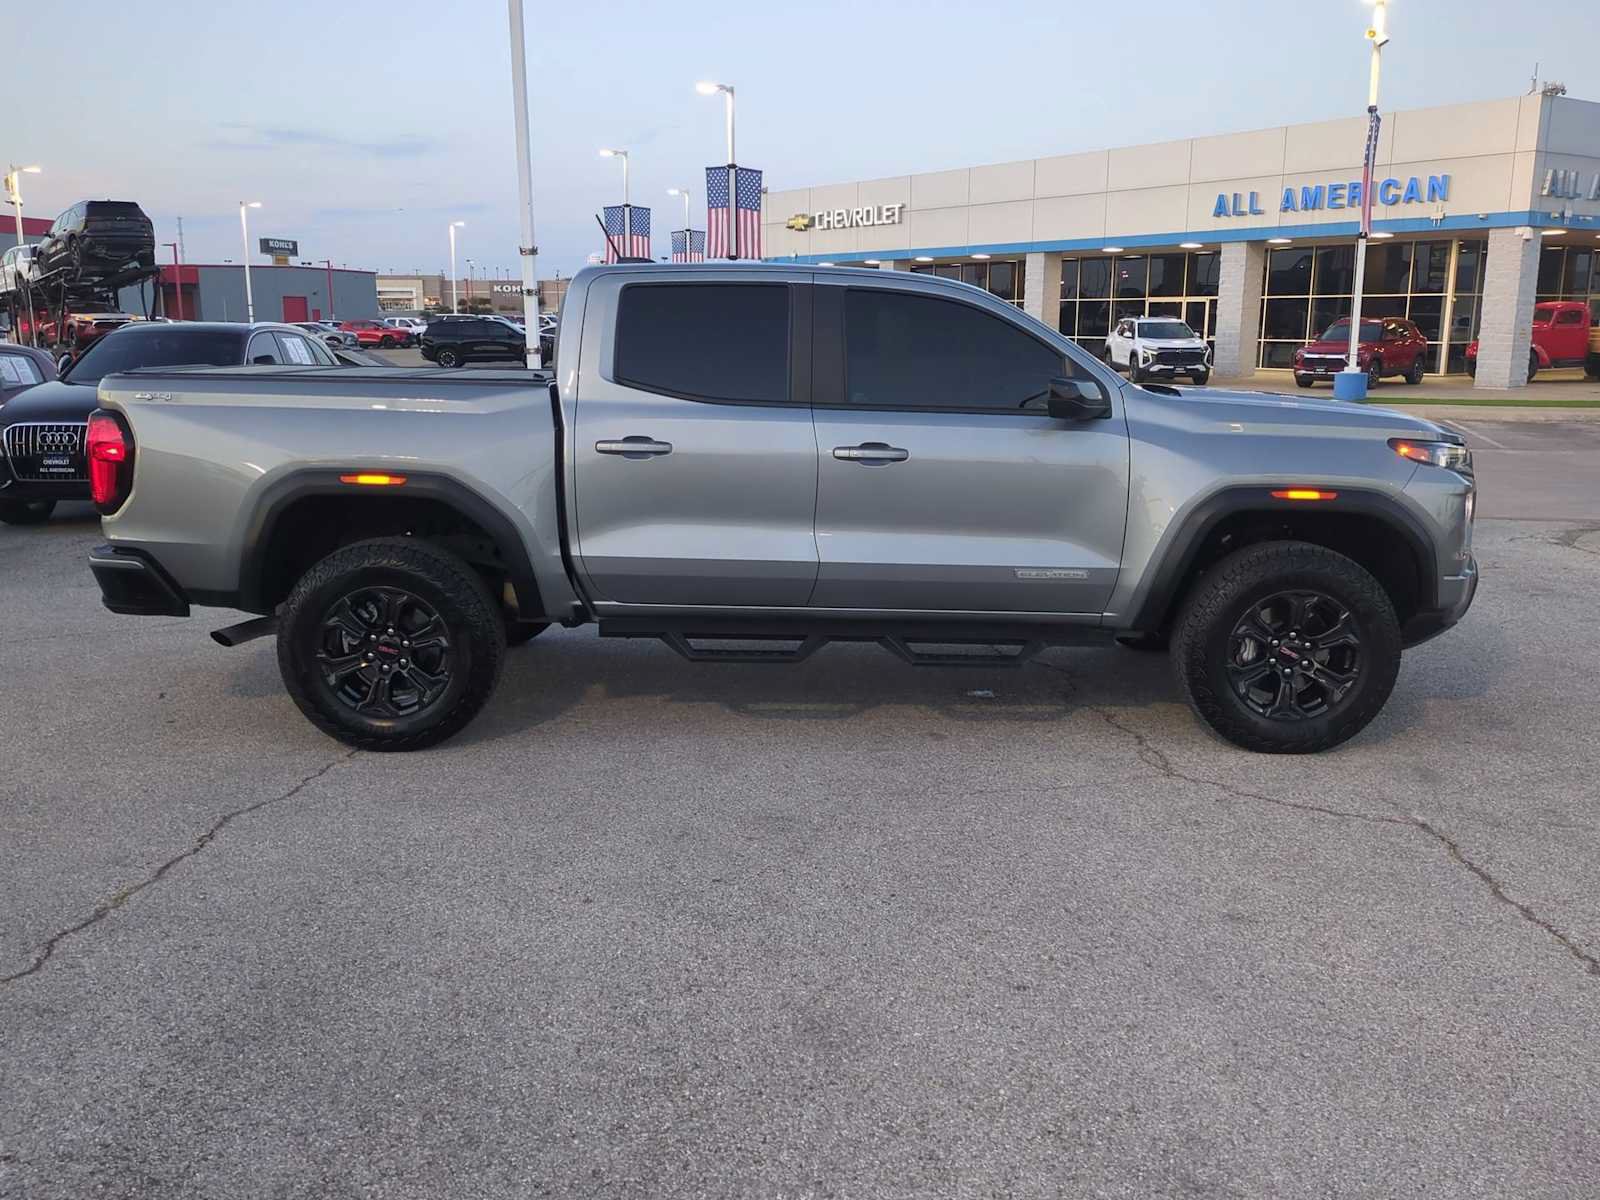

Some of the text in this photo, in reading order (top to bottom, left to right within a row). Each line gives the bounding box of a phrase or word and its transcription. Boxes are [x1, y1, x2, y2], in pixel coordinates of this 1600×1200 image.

[1541, 168, 1582, 199] ALL
[815, 203, 904, 230] CHEVROLET
[1213, 191, 1265, 217] ALL
